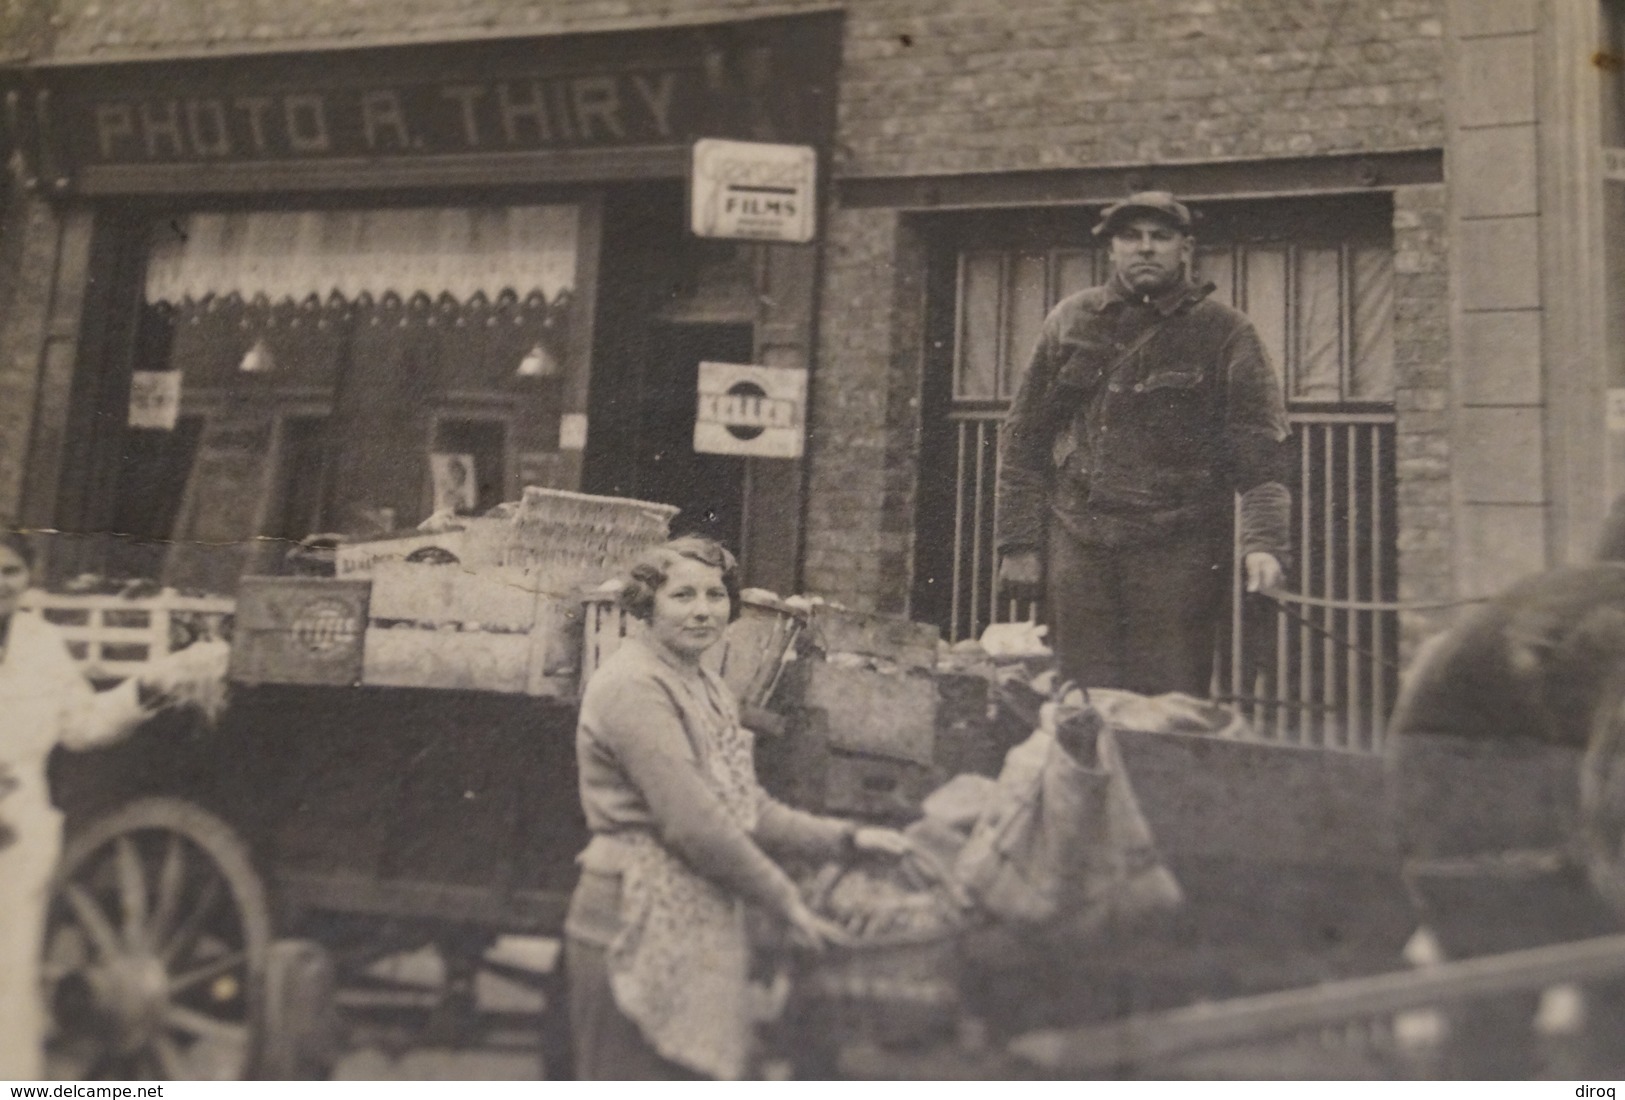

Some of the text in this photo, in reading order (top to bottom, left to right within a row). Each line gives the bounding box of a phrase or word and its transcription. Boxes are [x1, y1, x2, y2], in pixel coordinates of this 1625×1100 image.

[98, 95, 329, 157] PHOTO
[441, 72, 678, 146] THIRY
[724, 197, 797, 217] FILMS
